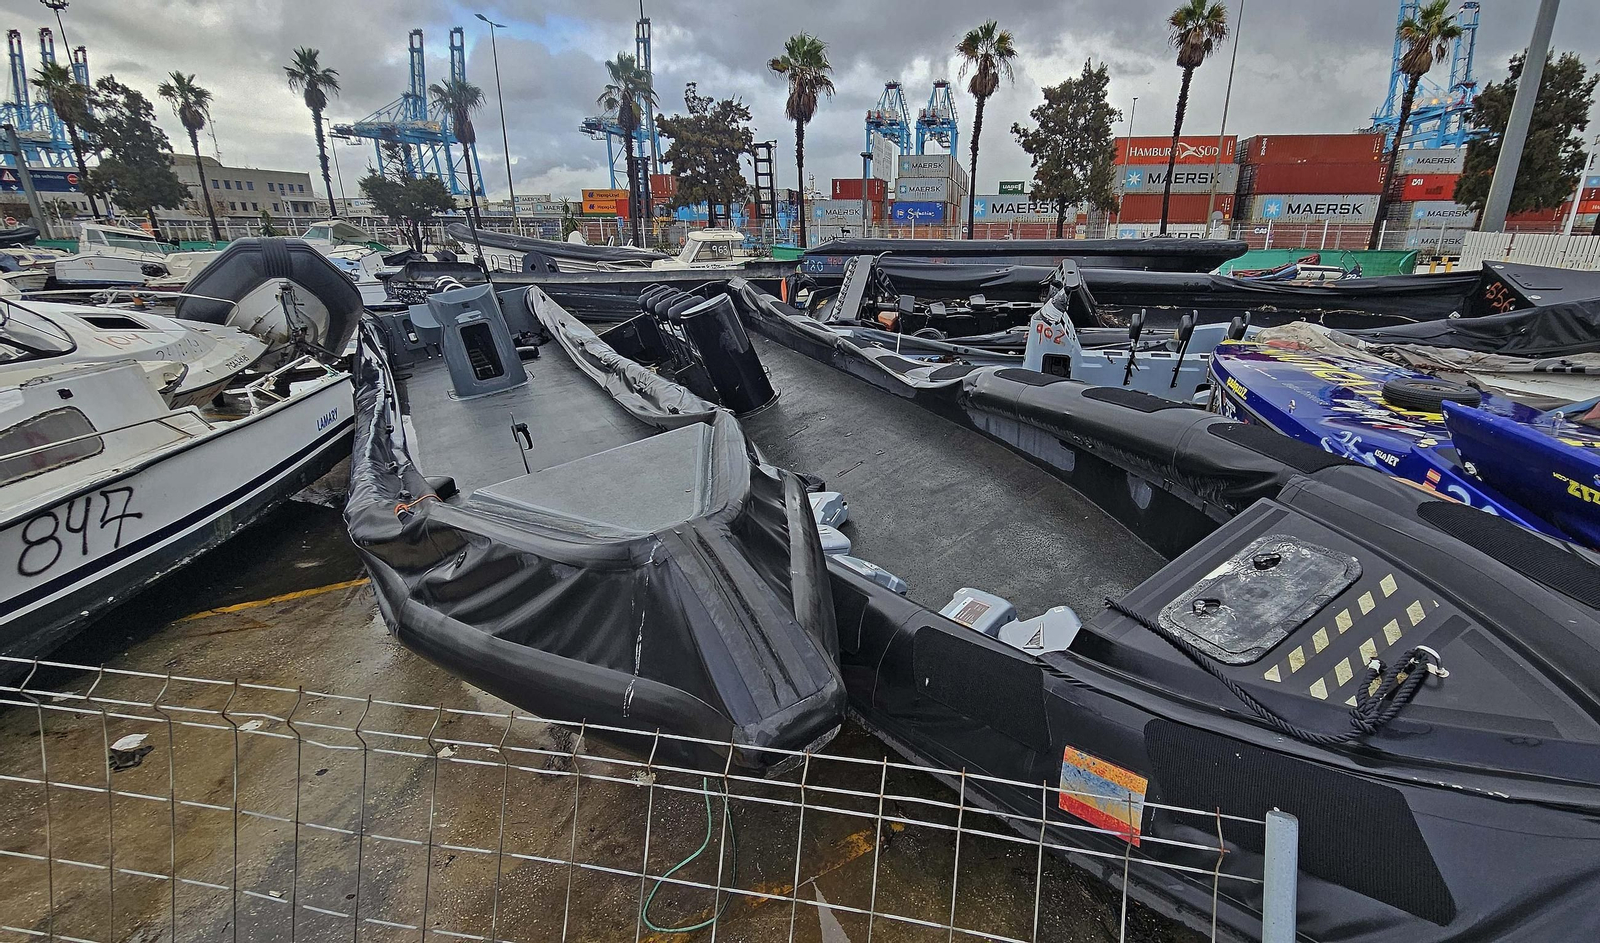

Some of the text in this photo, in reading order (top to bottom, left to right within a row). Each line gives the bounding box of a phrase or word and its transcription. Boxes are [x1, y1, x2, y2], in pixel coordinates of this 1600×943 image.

[1199, 145, 1219, 156] SÜD
[1147, 172, 1221, 184] MAERSK
[991, 203, 1060, 214] MAERSK
[1286, 203, 1364, 215] MAERSK
[1420, 237, 1462, 245] MAERSK
[711, 244, 728, 258] 963
[1036, 322, 1066, 346] 902
[94, 332, 153, 351] 104
[316, 406, 338, 432] LAMARY
[17, 485, 144, 578] 847
